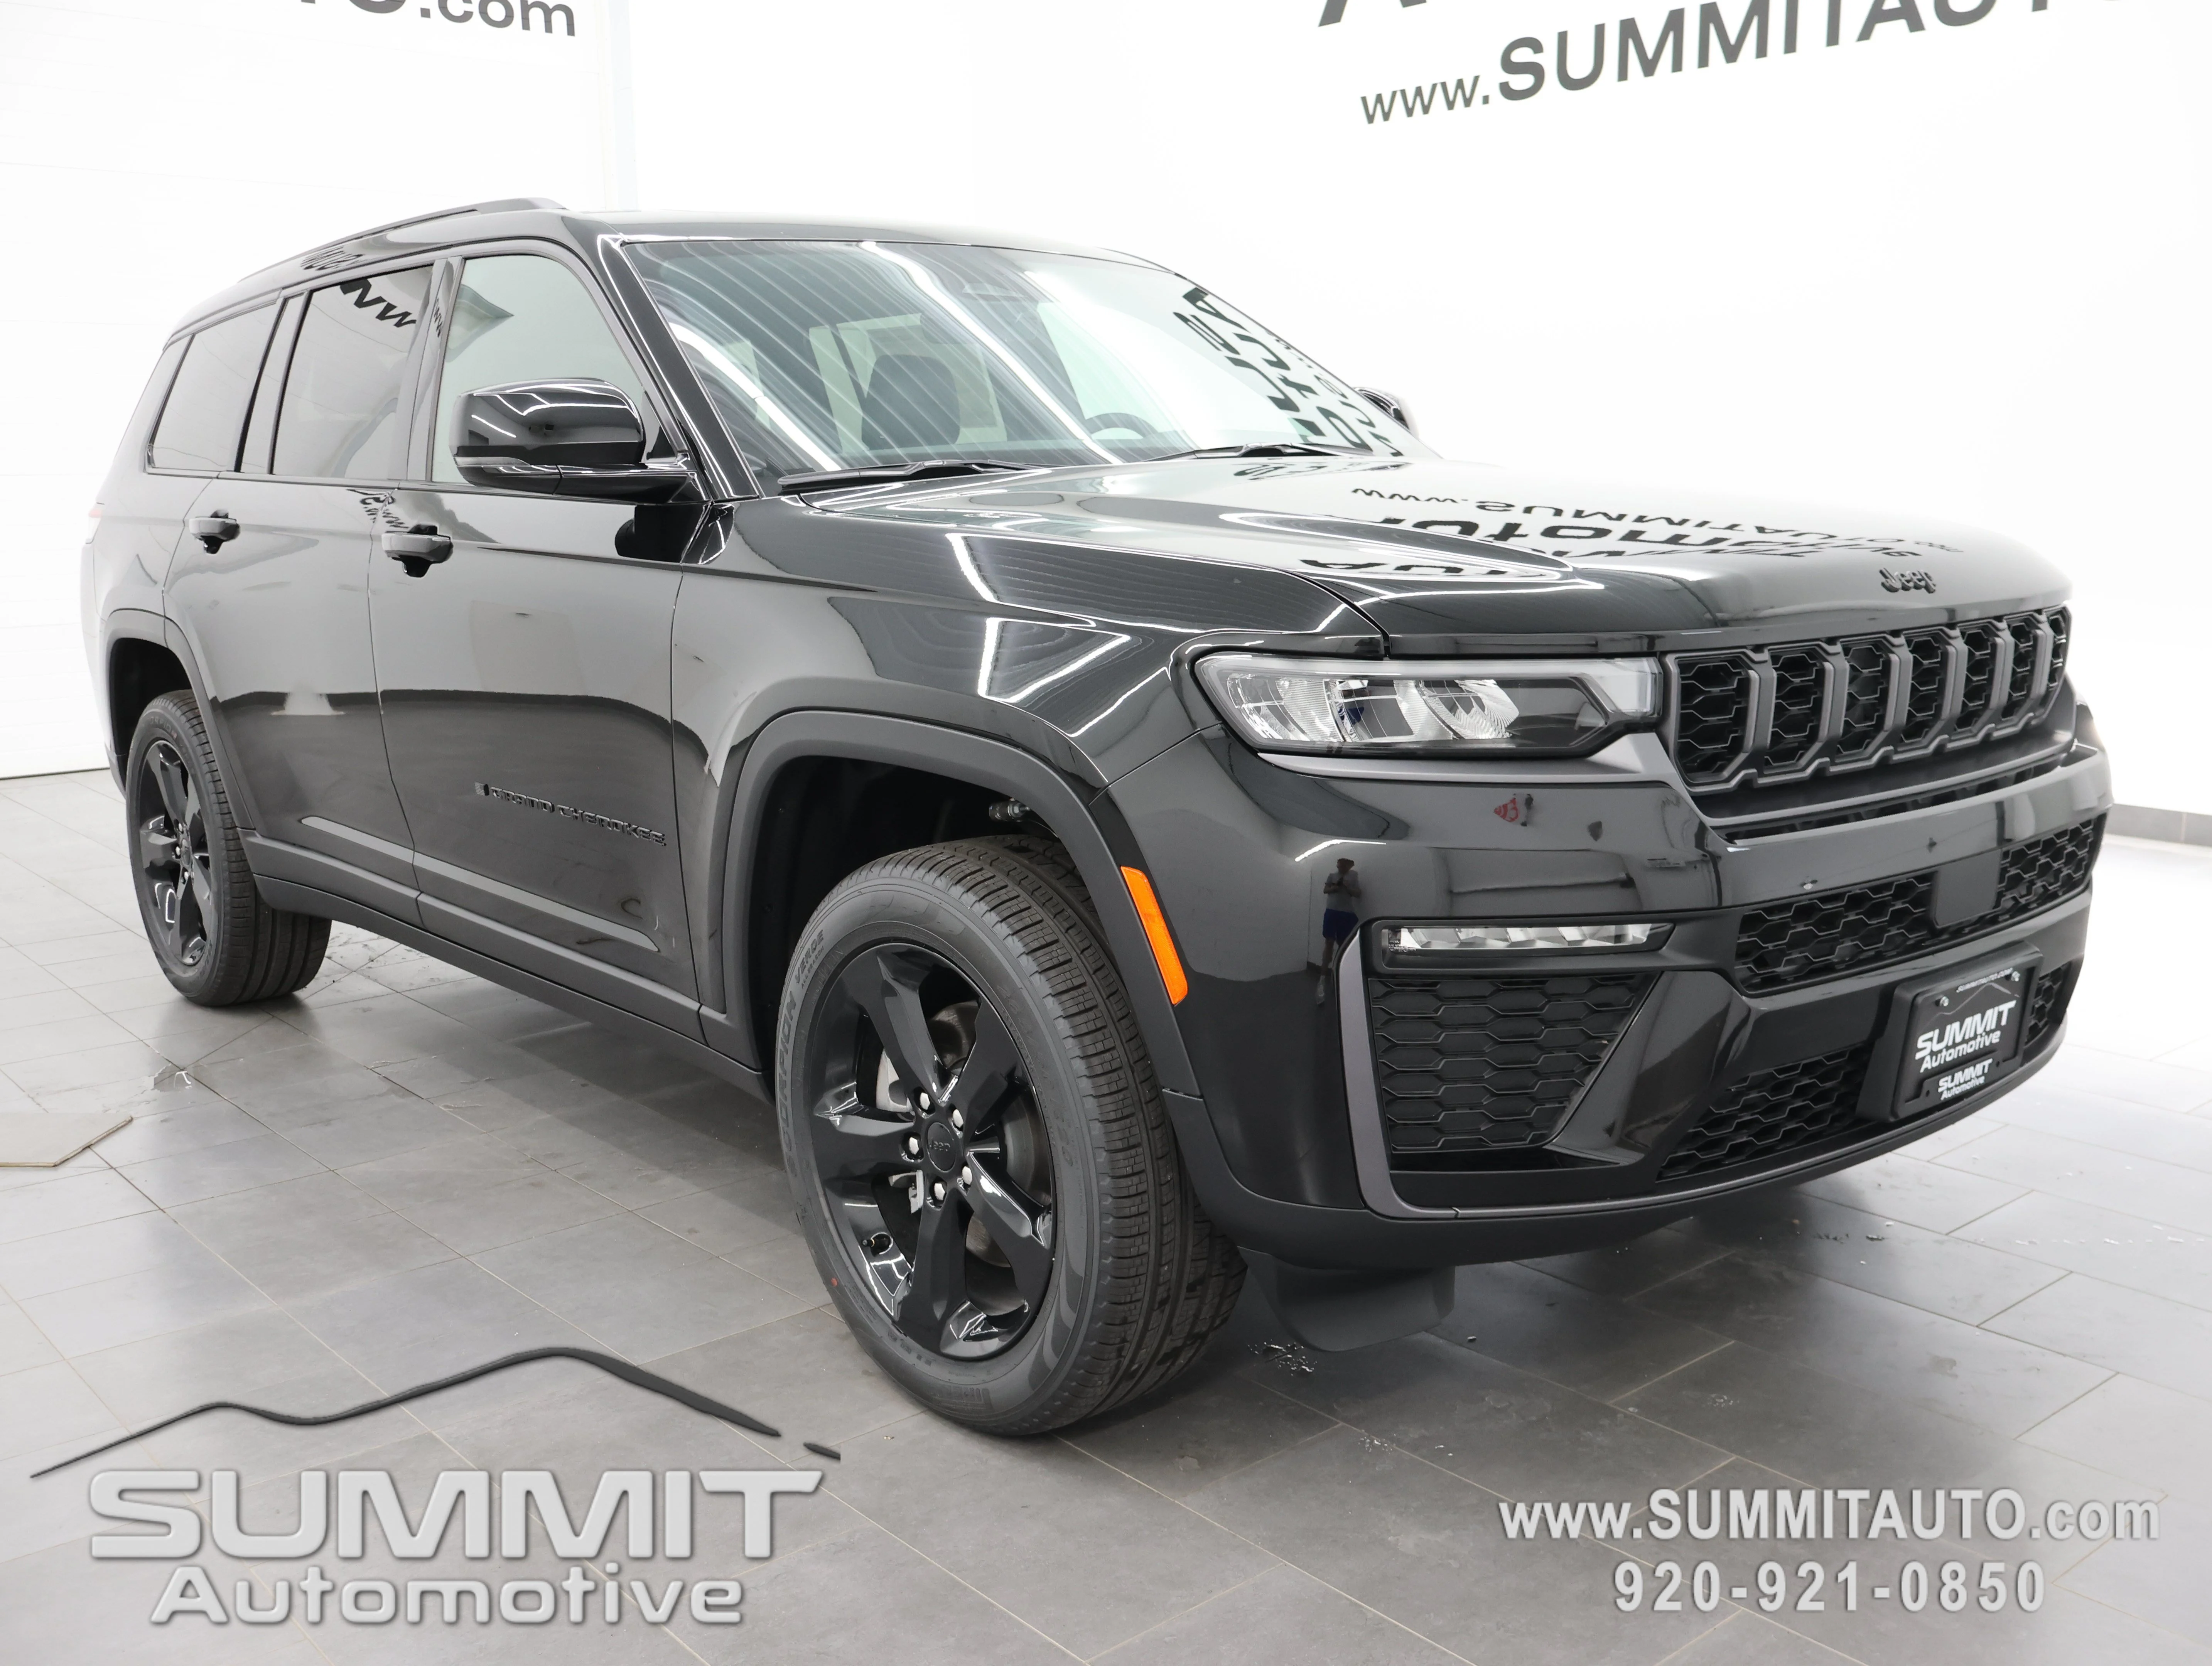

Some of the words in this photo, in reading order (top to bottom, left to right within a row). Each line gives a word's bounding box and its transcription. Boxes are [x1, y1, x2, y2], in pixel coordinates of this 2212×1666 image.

[1879, 568, 1936, 594] Jeep
[490, 786, 555, 813] GRAND
[557, 804, 667, 846] CHEROKEE
[795, 929, 824, 984] VERDE
[1915, 1000, 2016, 1060] SUMMIT
[1920, 1030, 2001, 1073] Automotive
[1937, 1058, 1993, 1093] SUMMIT
[1940, 1076, 1985, 1100] Automotive
